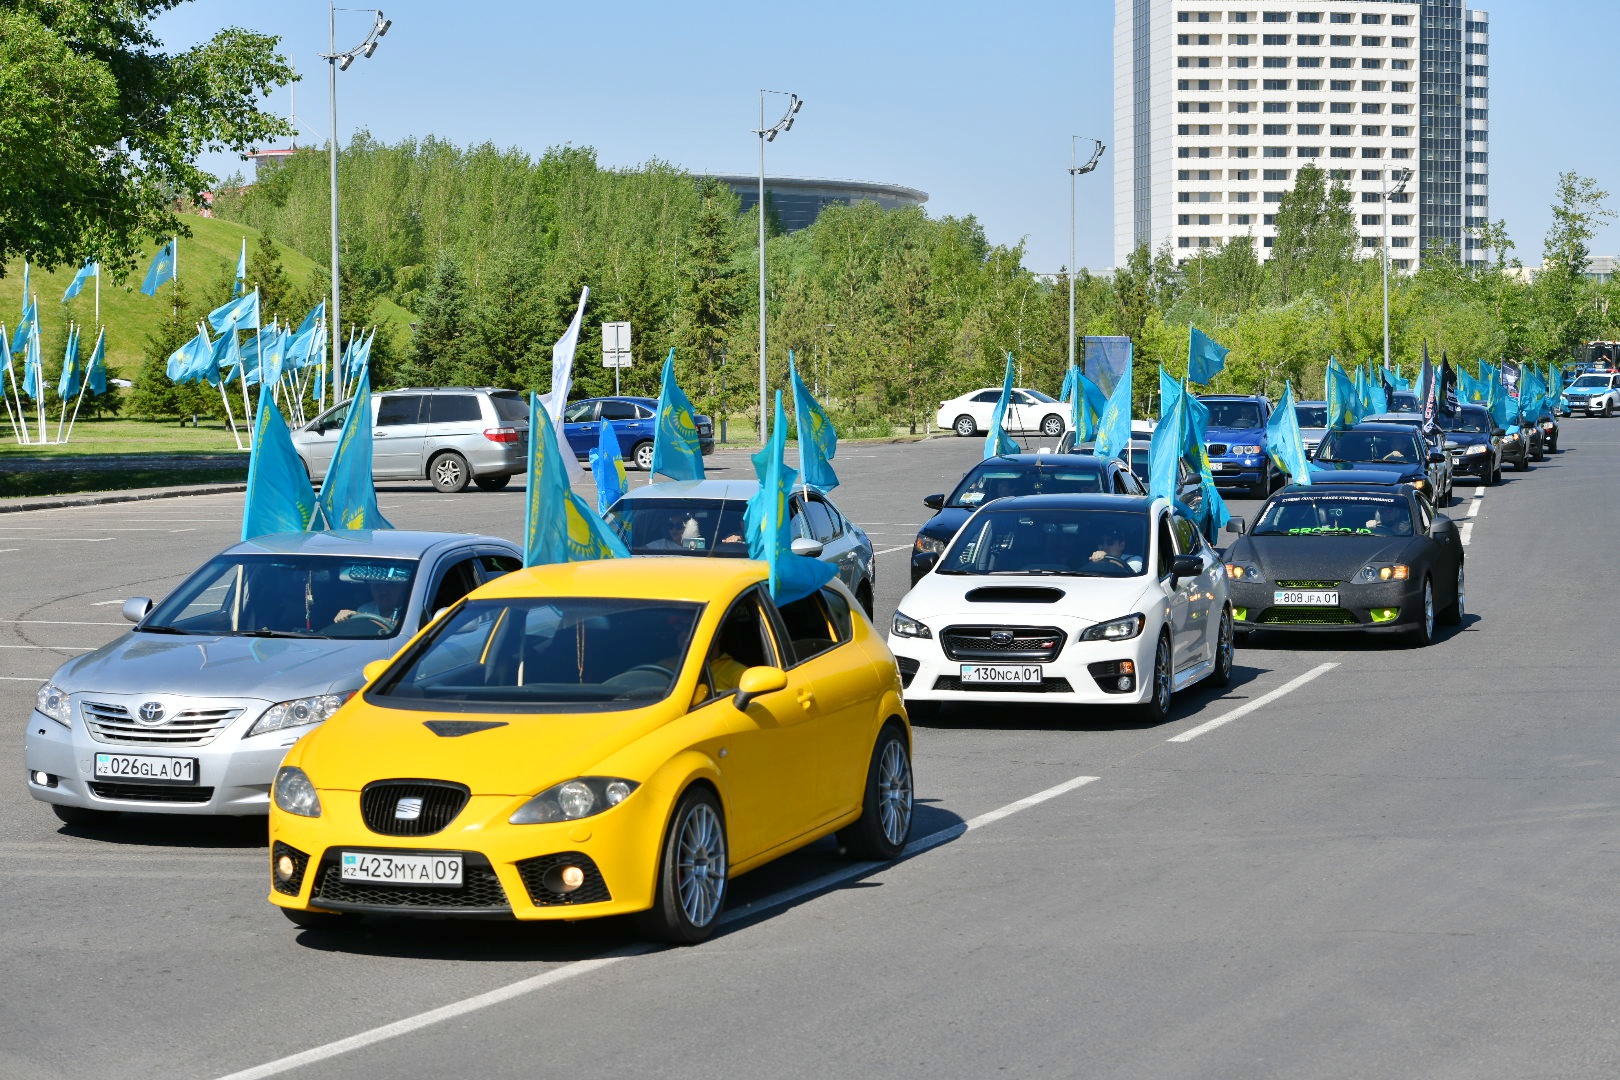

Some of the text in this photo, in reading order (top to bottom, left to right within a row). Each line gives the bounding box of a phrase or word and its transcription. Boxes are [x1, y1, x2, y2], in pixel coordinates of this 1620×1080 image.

[1283, 592, 1303, 603] 808
[1324, 593, 1337, 603] 01
[974, 667, 1020, 681] 130NCA
[1023, 668, 1039, 681] 01
[111, 757, 168, 777] 026GLA
[173, 760, 192, 778] 01
[343, 856, 459, 880] KZ 423MYA 09
